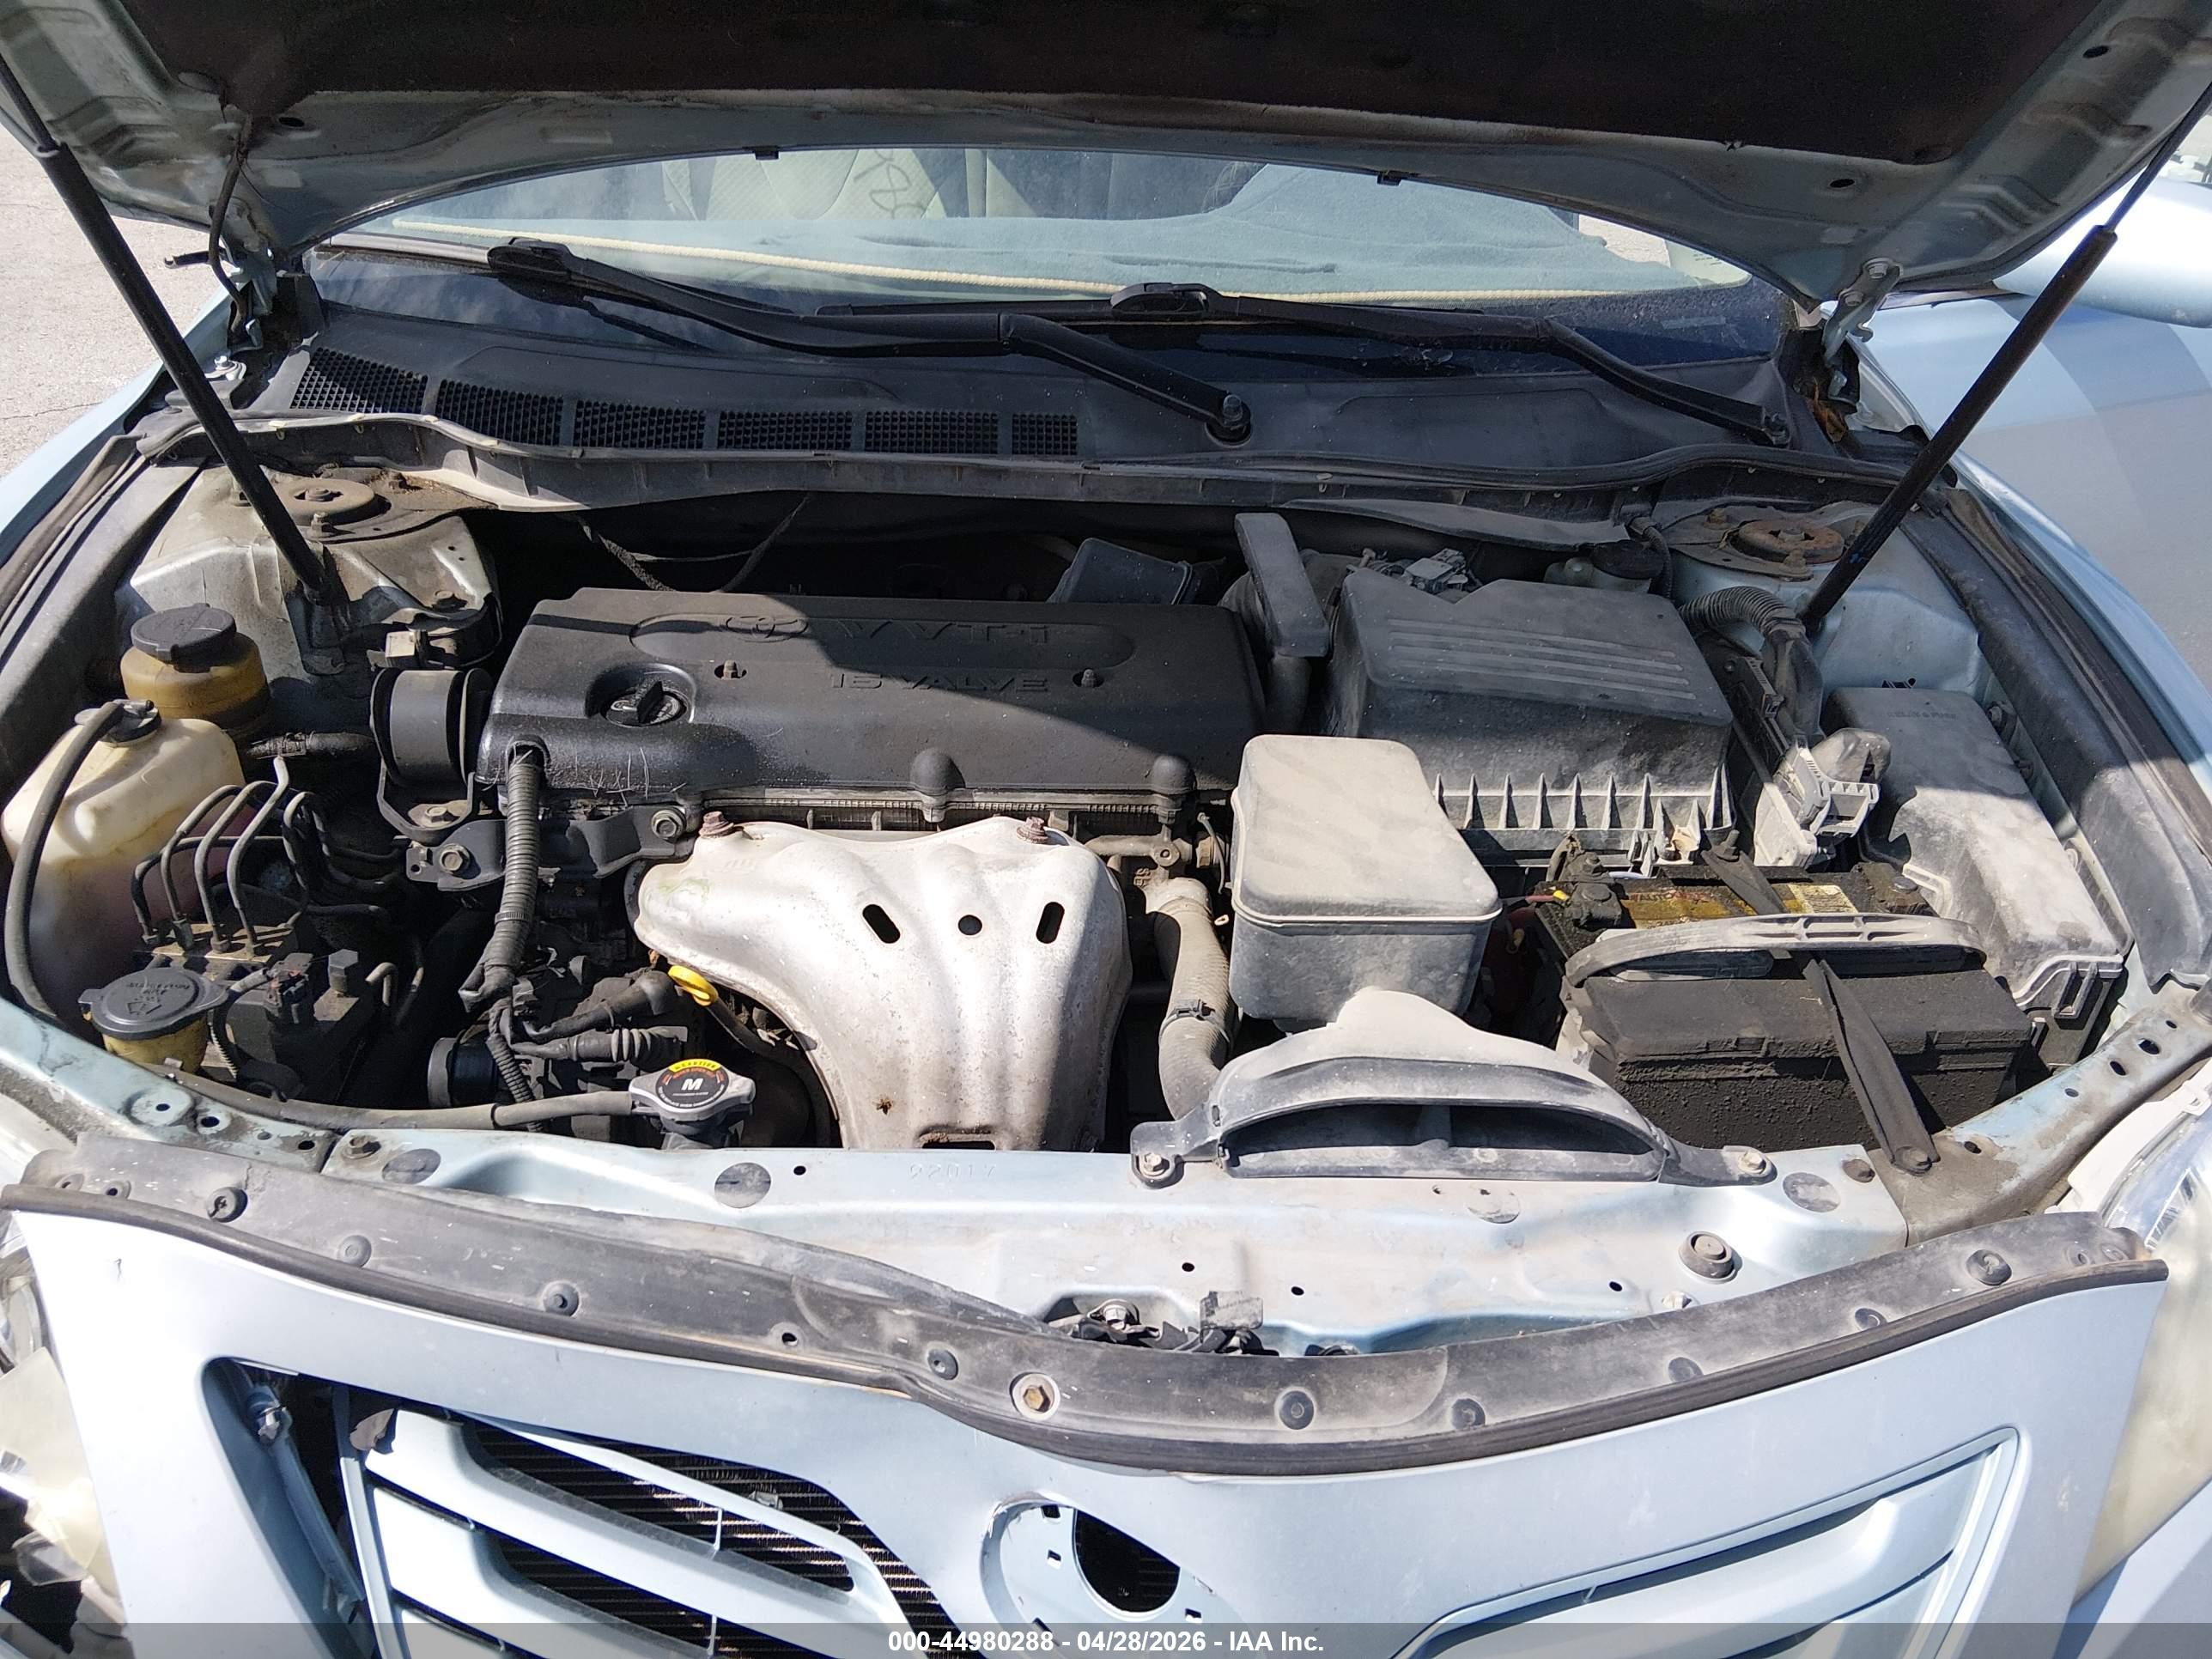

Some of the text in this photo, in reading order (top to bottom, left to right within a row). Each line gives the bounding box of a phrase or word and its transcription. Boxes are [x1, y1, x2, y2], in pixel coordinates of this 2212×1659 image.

[831, 672, 1048, 693] 16 VALVE
[681, 1079, 704, 1091] M
